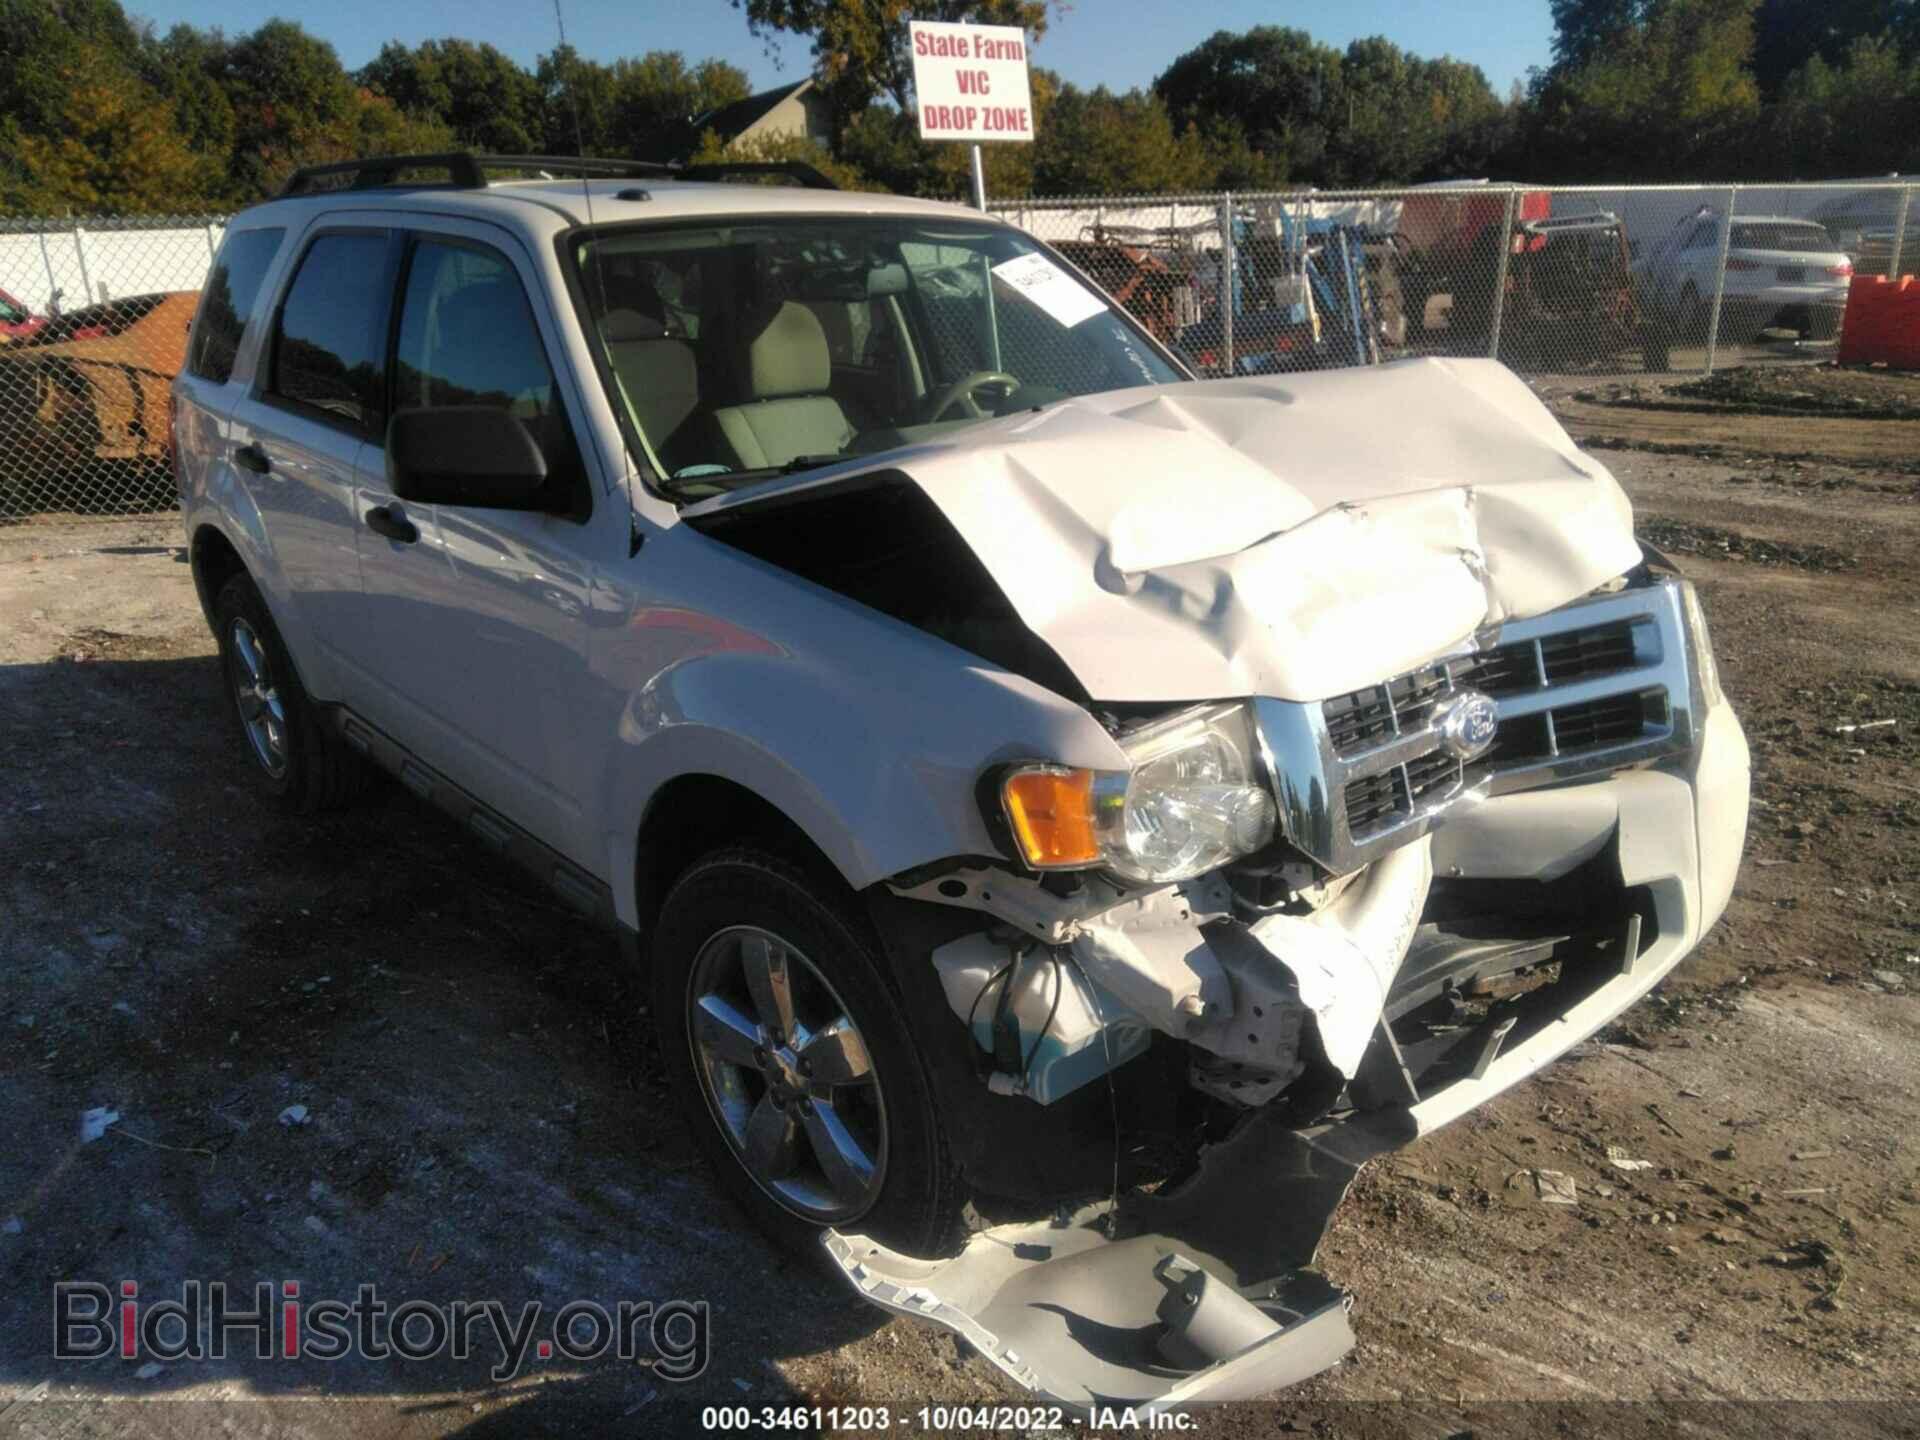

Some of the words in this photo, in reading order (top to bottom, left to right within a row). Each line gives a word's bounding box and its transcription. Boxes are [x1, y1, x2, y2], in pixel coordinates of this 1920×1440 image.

[914, 31, 969, 58] State
[973, 34, 1024, 61] Farm
[956, 70, 990, 95] VIC
[924, 105, 977, 130] DROP
[982, 107, 1029, 131] ZONE
